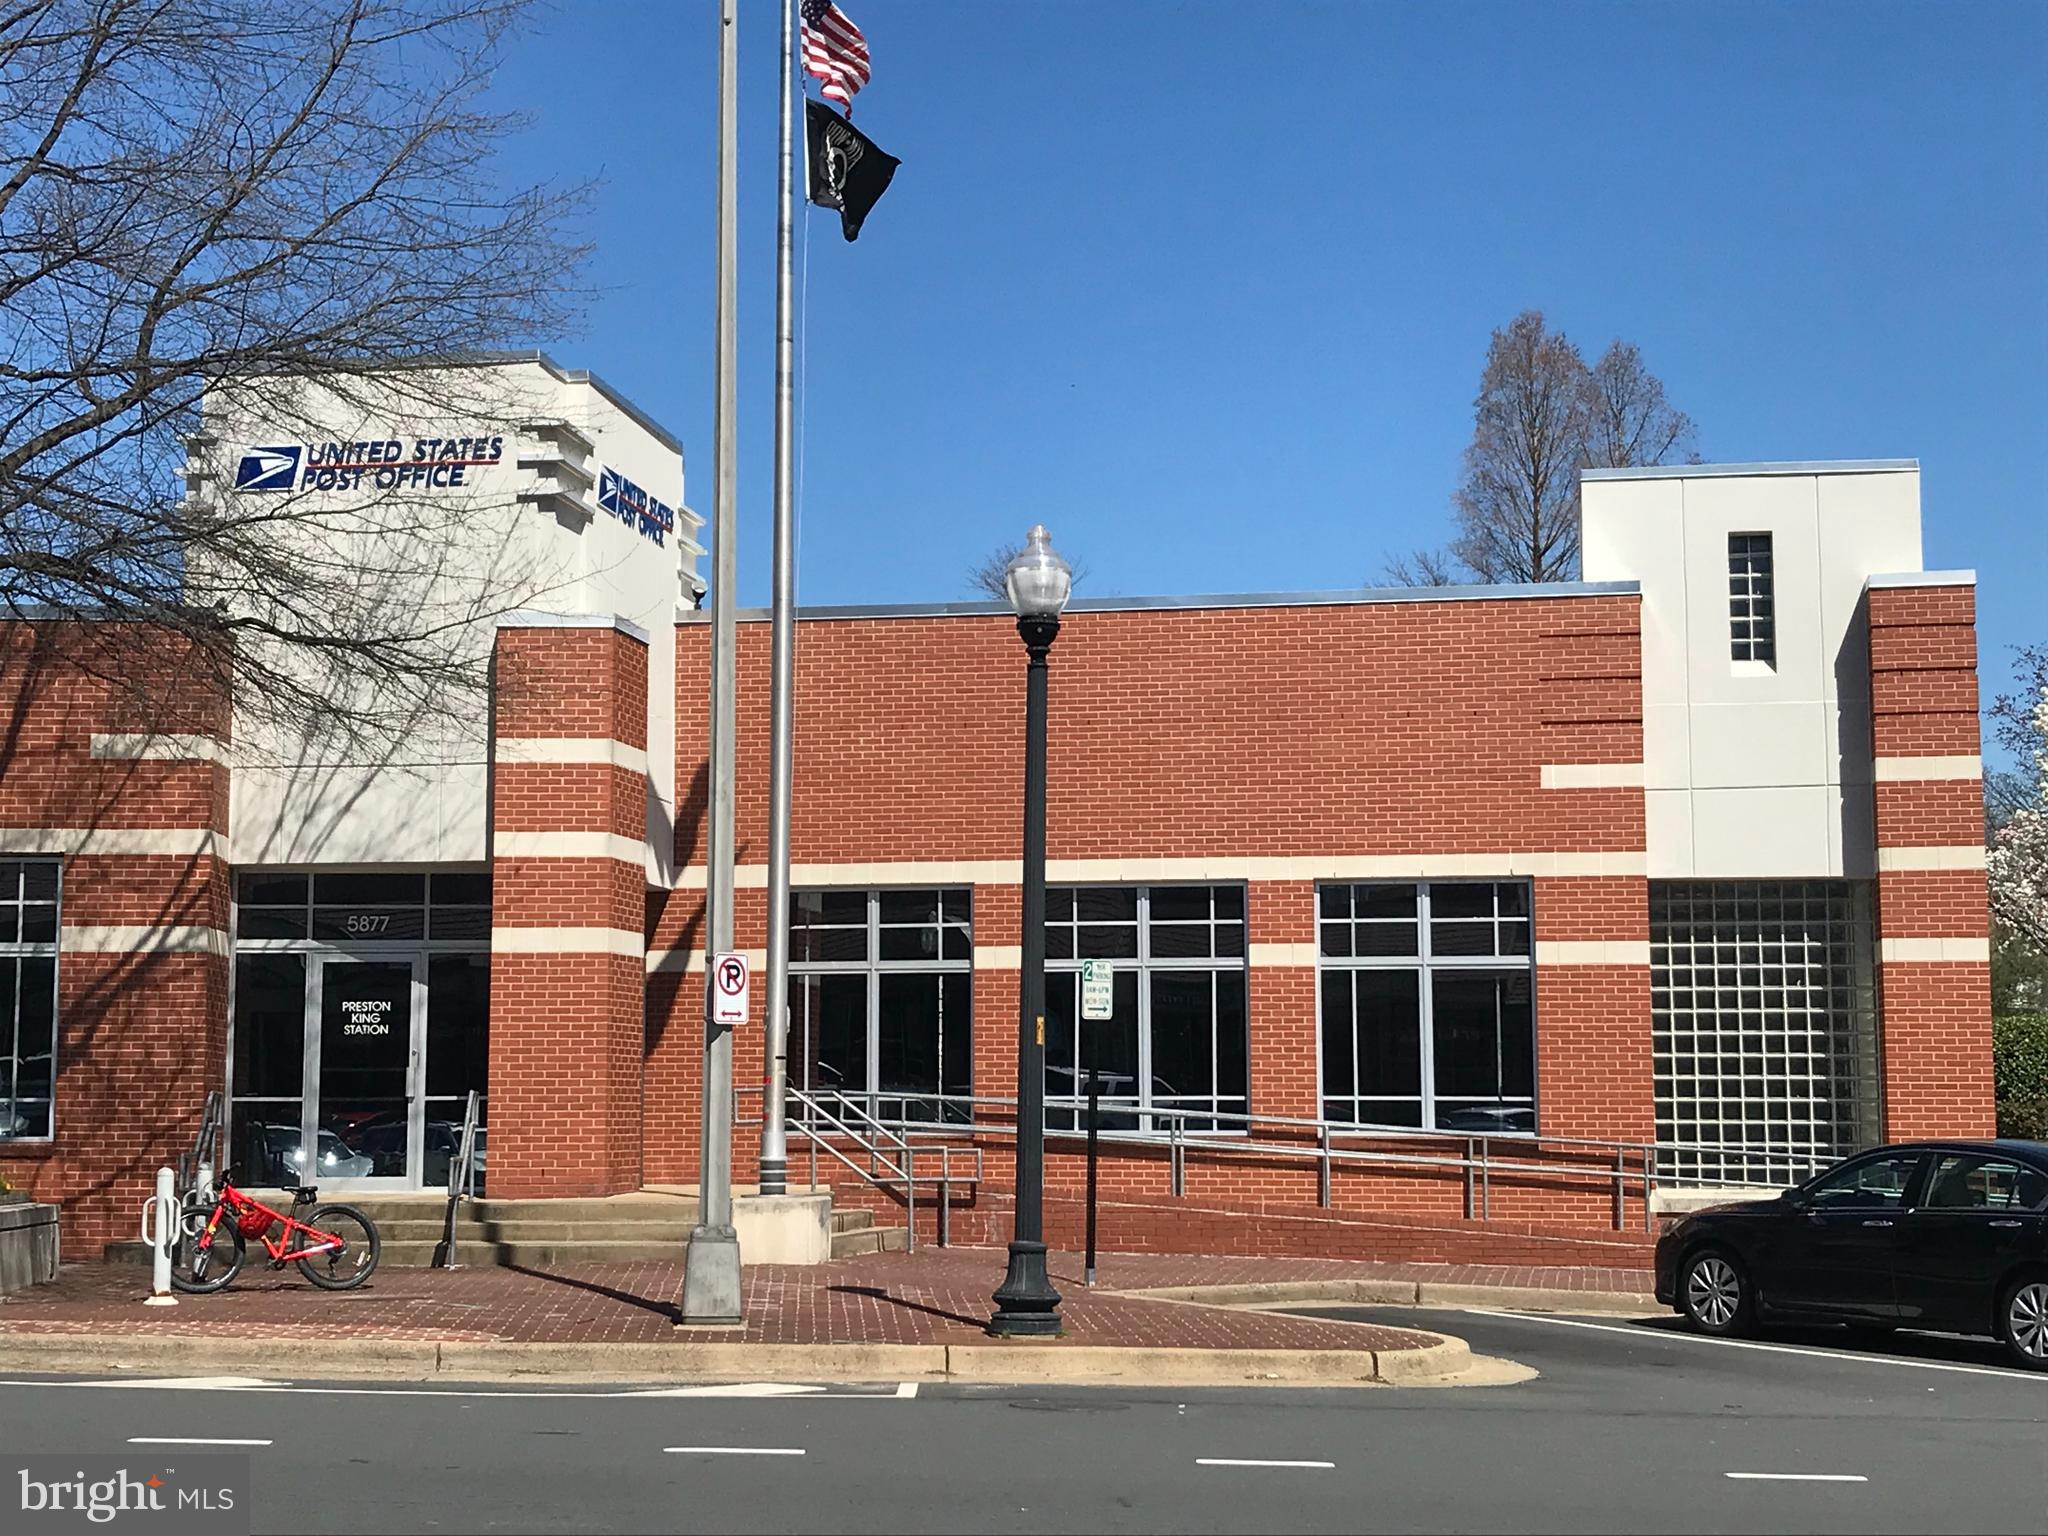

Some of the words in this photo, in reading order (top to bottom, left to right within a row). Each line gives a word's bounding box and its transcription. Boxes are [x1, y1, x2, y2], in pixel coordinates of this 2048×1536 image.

[307, 440, 402, 466] UNITED
[414, 435, 503, 462] STATES
[300, 465, 364, 492] POST
[347, 915, 390, 932] 5877
[1084, 963, 1092, 980] 2
[342, 1001, 391, 1012] PRESTON
[351, 1012, 381, 1024] KING
[343, 1024, 389, 1035] STATION
